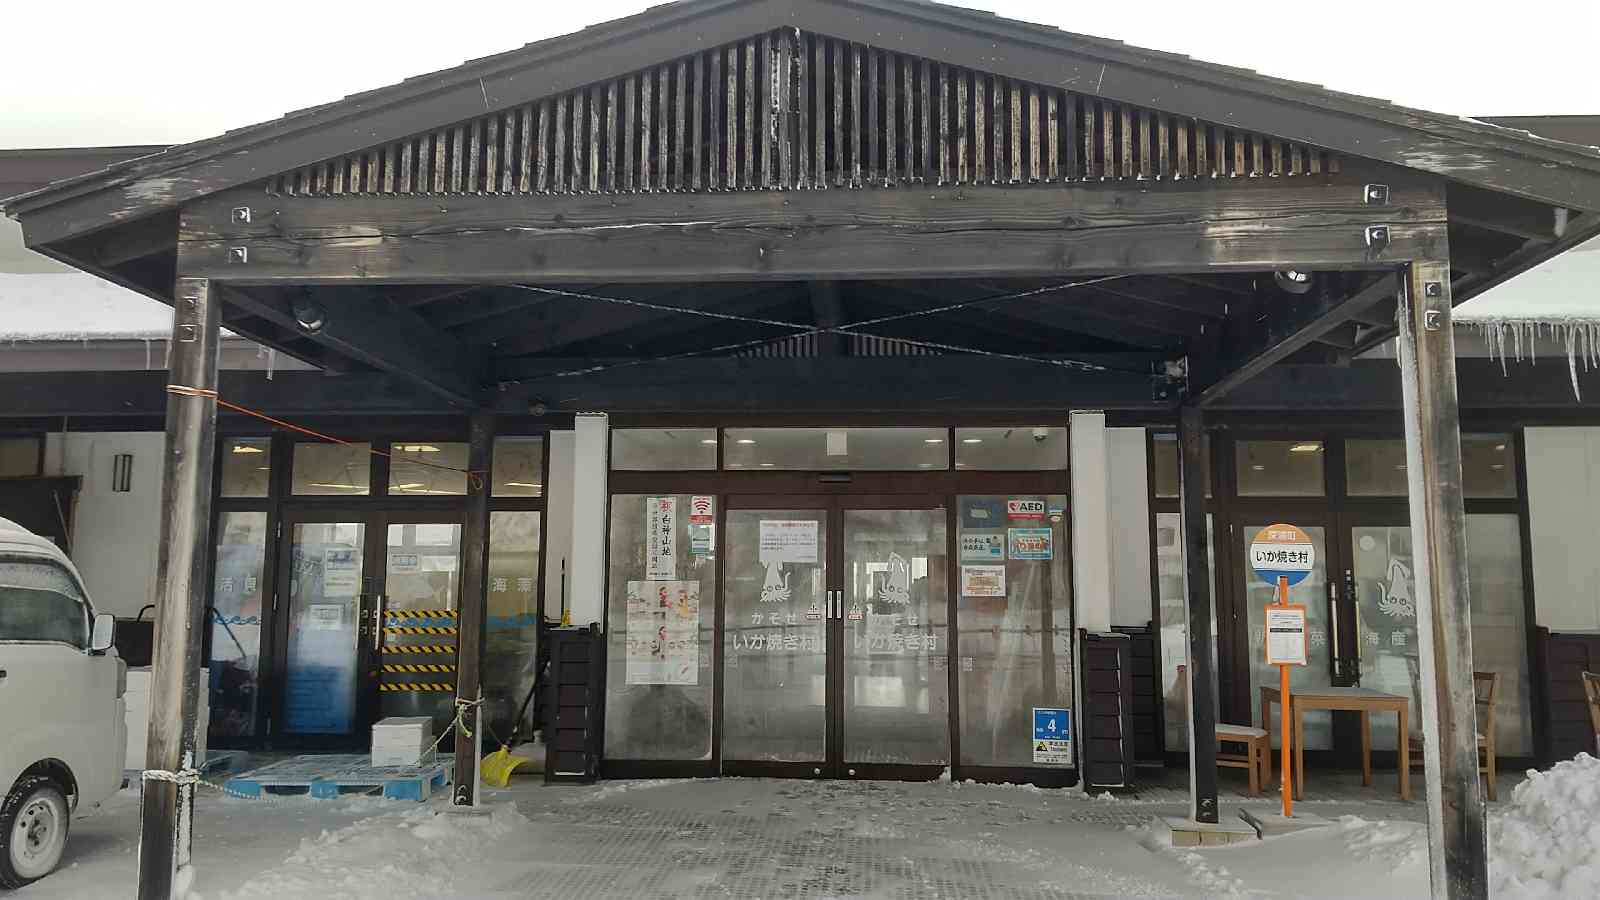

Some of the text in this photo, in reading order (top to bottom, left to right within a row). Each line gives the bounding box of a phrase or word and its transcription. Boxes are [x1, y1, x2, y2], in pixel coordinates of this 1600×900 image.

[1019, 502, 1043, 512] AED
[1256, 551, 1309, 564] いか焼き村
[733, 633, 818, 650] いか焼き村
[1047, 718, 1057, 733] 4
